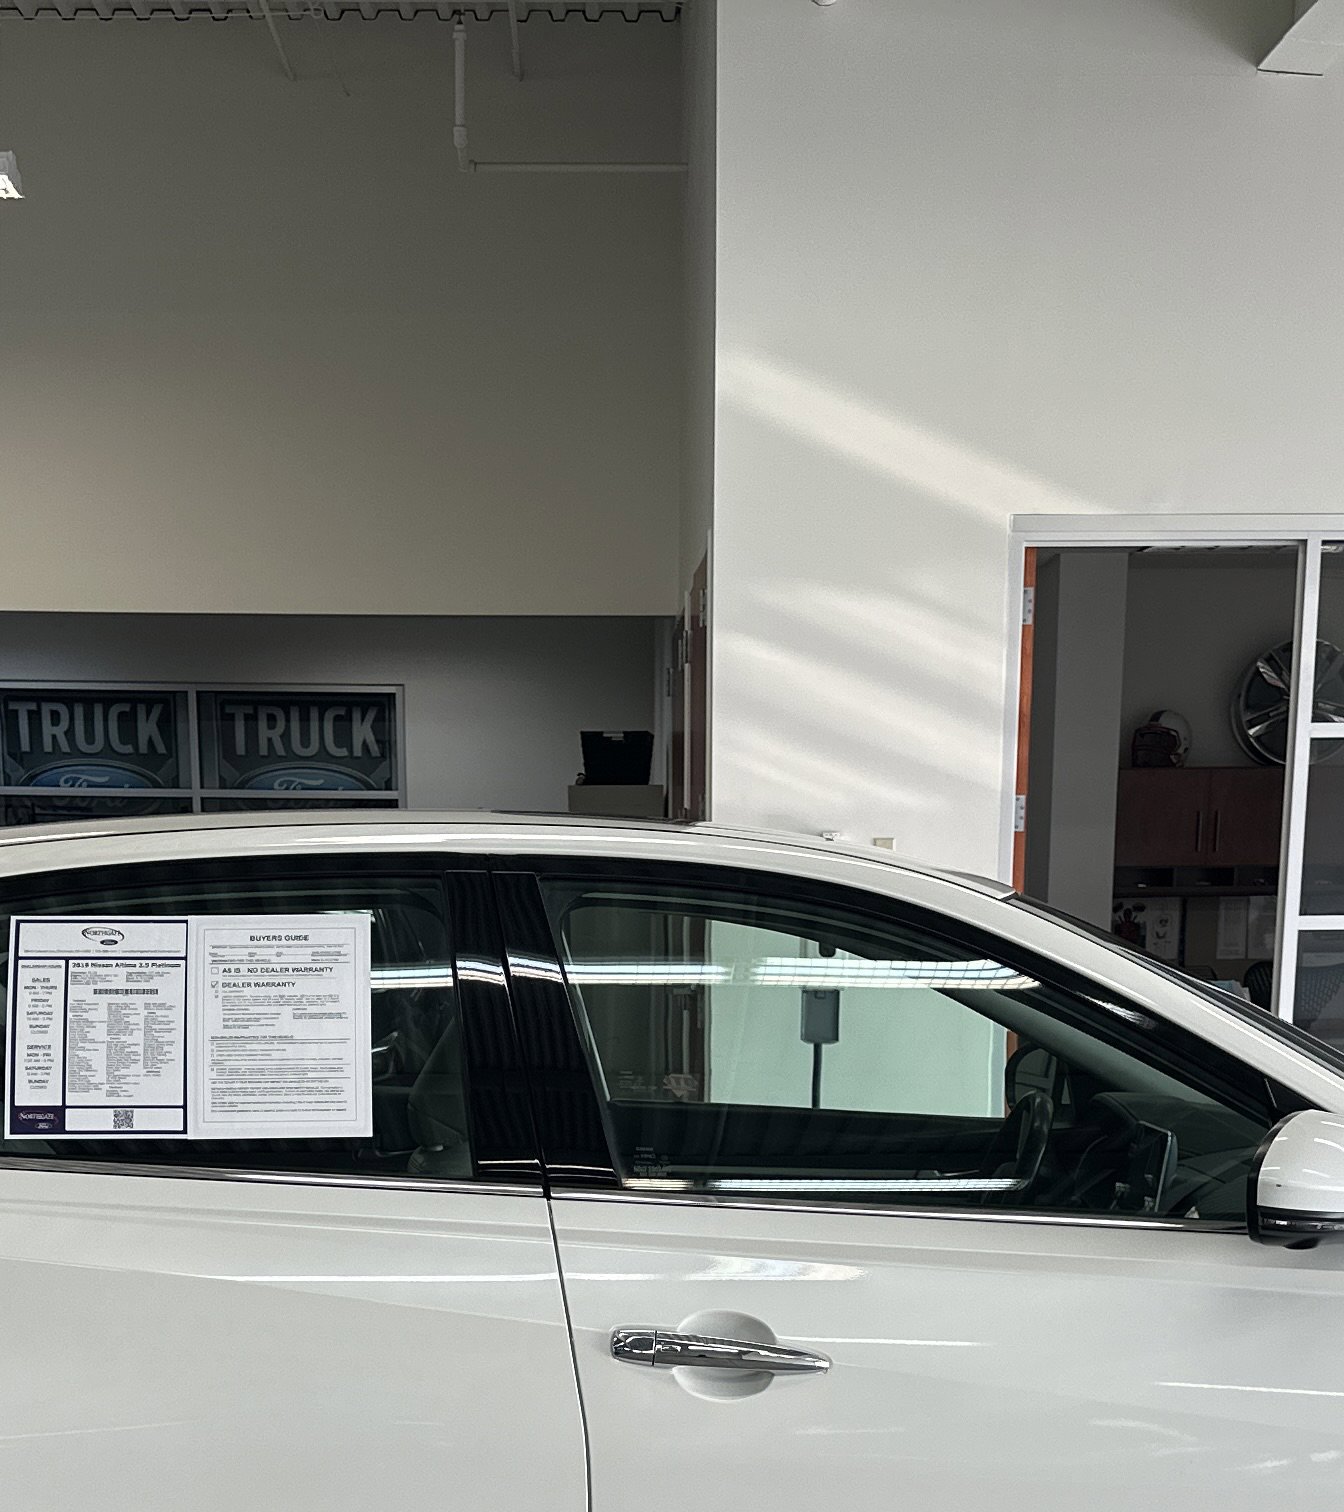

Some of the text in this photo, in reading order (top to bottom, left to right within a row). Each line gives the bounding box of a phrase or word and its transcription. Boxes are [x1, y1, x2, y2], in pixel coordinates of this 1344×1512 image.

[8, 701, 168, 755] TRUCK
[224, 704, 382, 758] TRUCK
[249, 934, 283, 942] BUYERS
